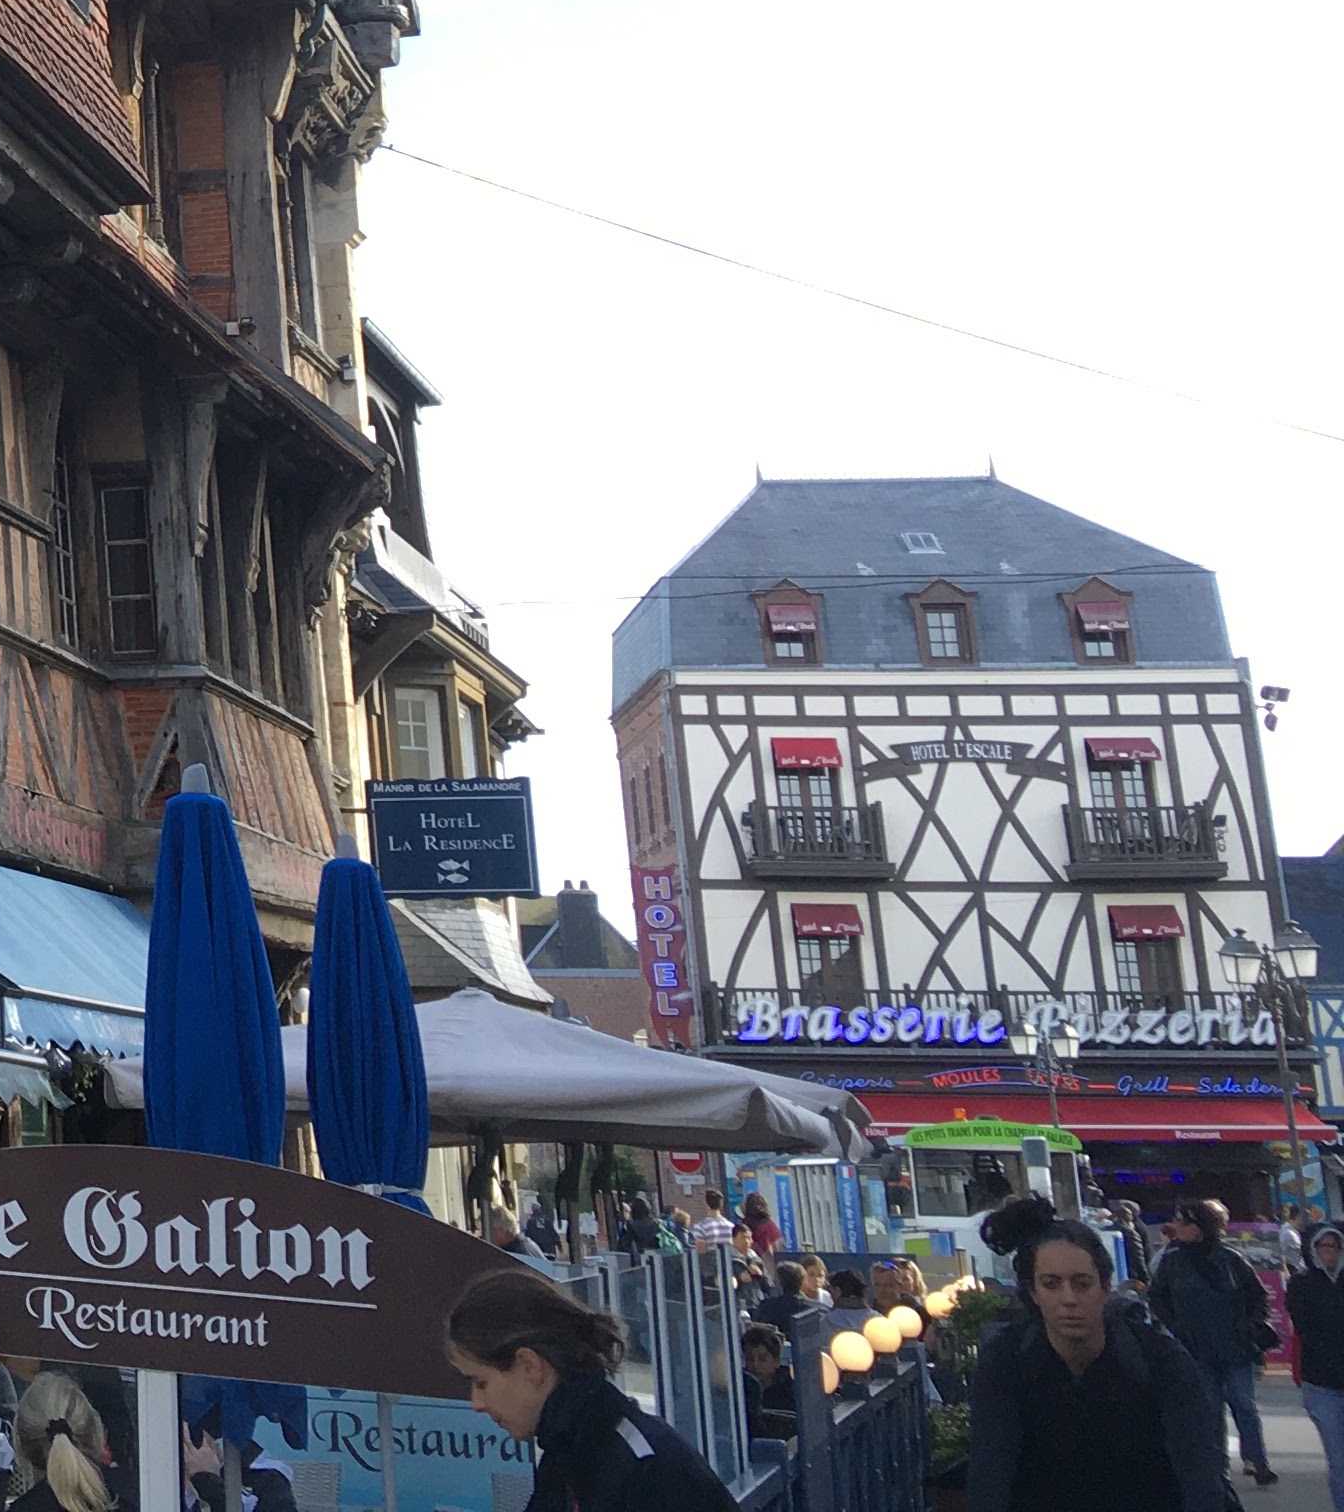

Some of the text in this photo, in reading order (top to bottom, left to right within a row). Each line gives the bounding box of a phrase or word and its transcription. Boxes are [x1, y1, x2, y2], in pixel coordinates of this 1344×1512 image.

[911, 742, 1013, 760] HOTEL L'ESCALE
[373, 781, 522, 793] MANOIR DE LA SALAMANDRE
[644, 876, 679, 1016] HOTEL
[737, 992, 1278, 1045] Brasserie Pizzeria
[933, 1069, 1001, 1088] MOULES
[1117, 1075, 1170, 1096] Grill
[63, 1187, 376, 1291] Galion
[25, 1287, 269, 1350] Restaurant
[312, 1410, 534, 1472] Restaura
